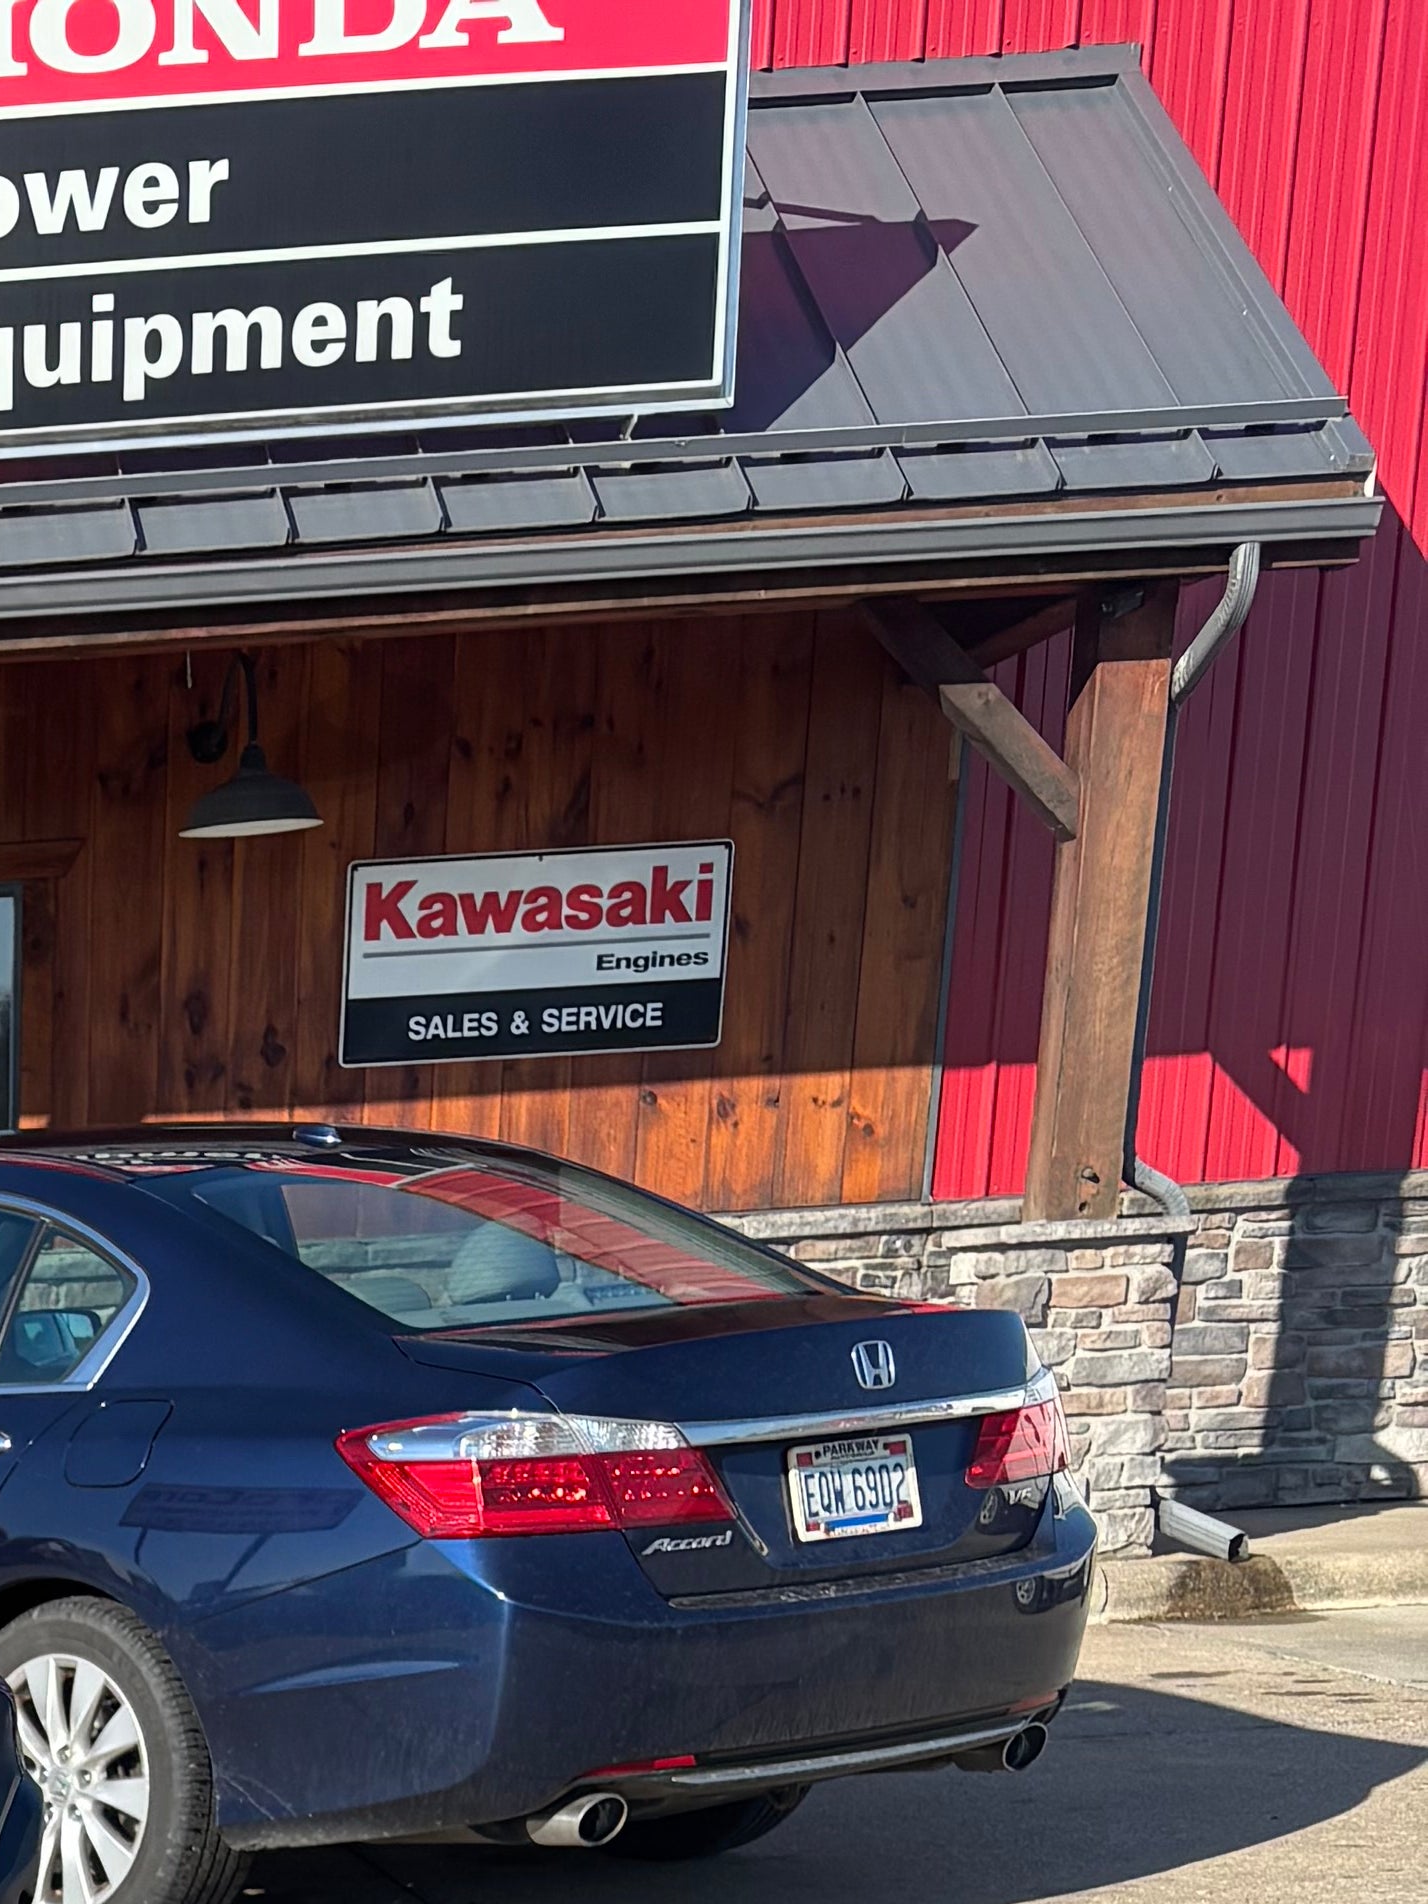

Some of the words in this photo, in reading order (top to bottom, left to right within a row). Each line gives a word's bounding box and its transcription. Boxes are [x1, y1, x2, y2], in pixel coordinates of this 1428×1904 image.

[363, 862, 715, 942] Kawasaki
[596, 950, 709, 973] Engines
[407, 1011, 499, 1041] SALES
[510, 1010, 530, 1035] &
[541, 1002, 664, 1033] SERVICE
[851, 1462, 910, 1512] 6902
[641, 1530, 733, 1556] Accord
